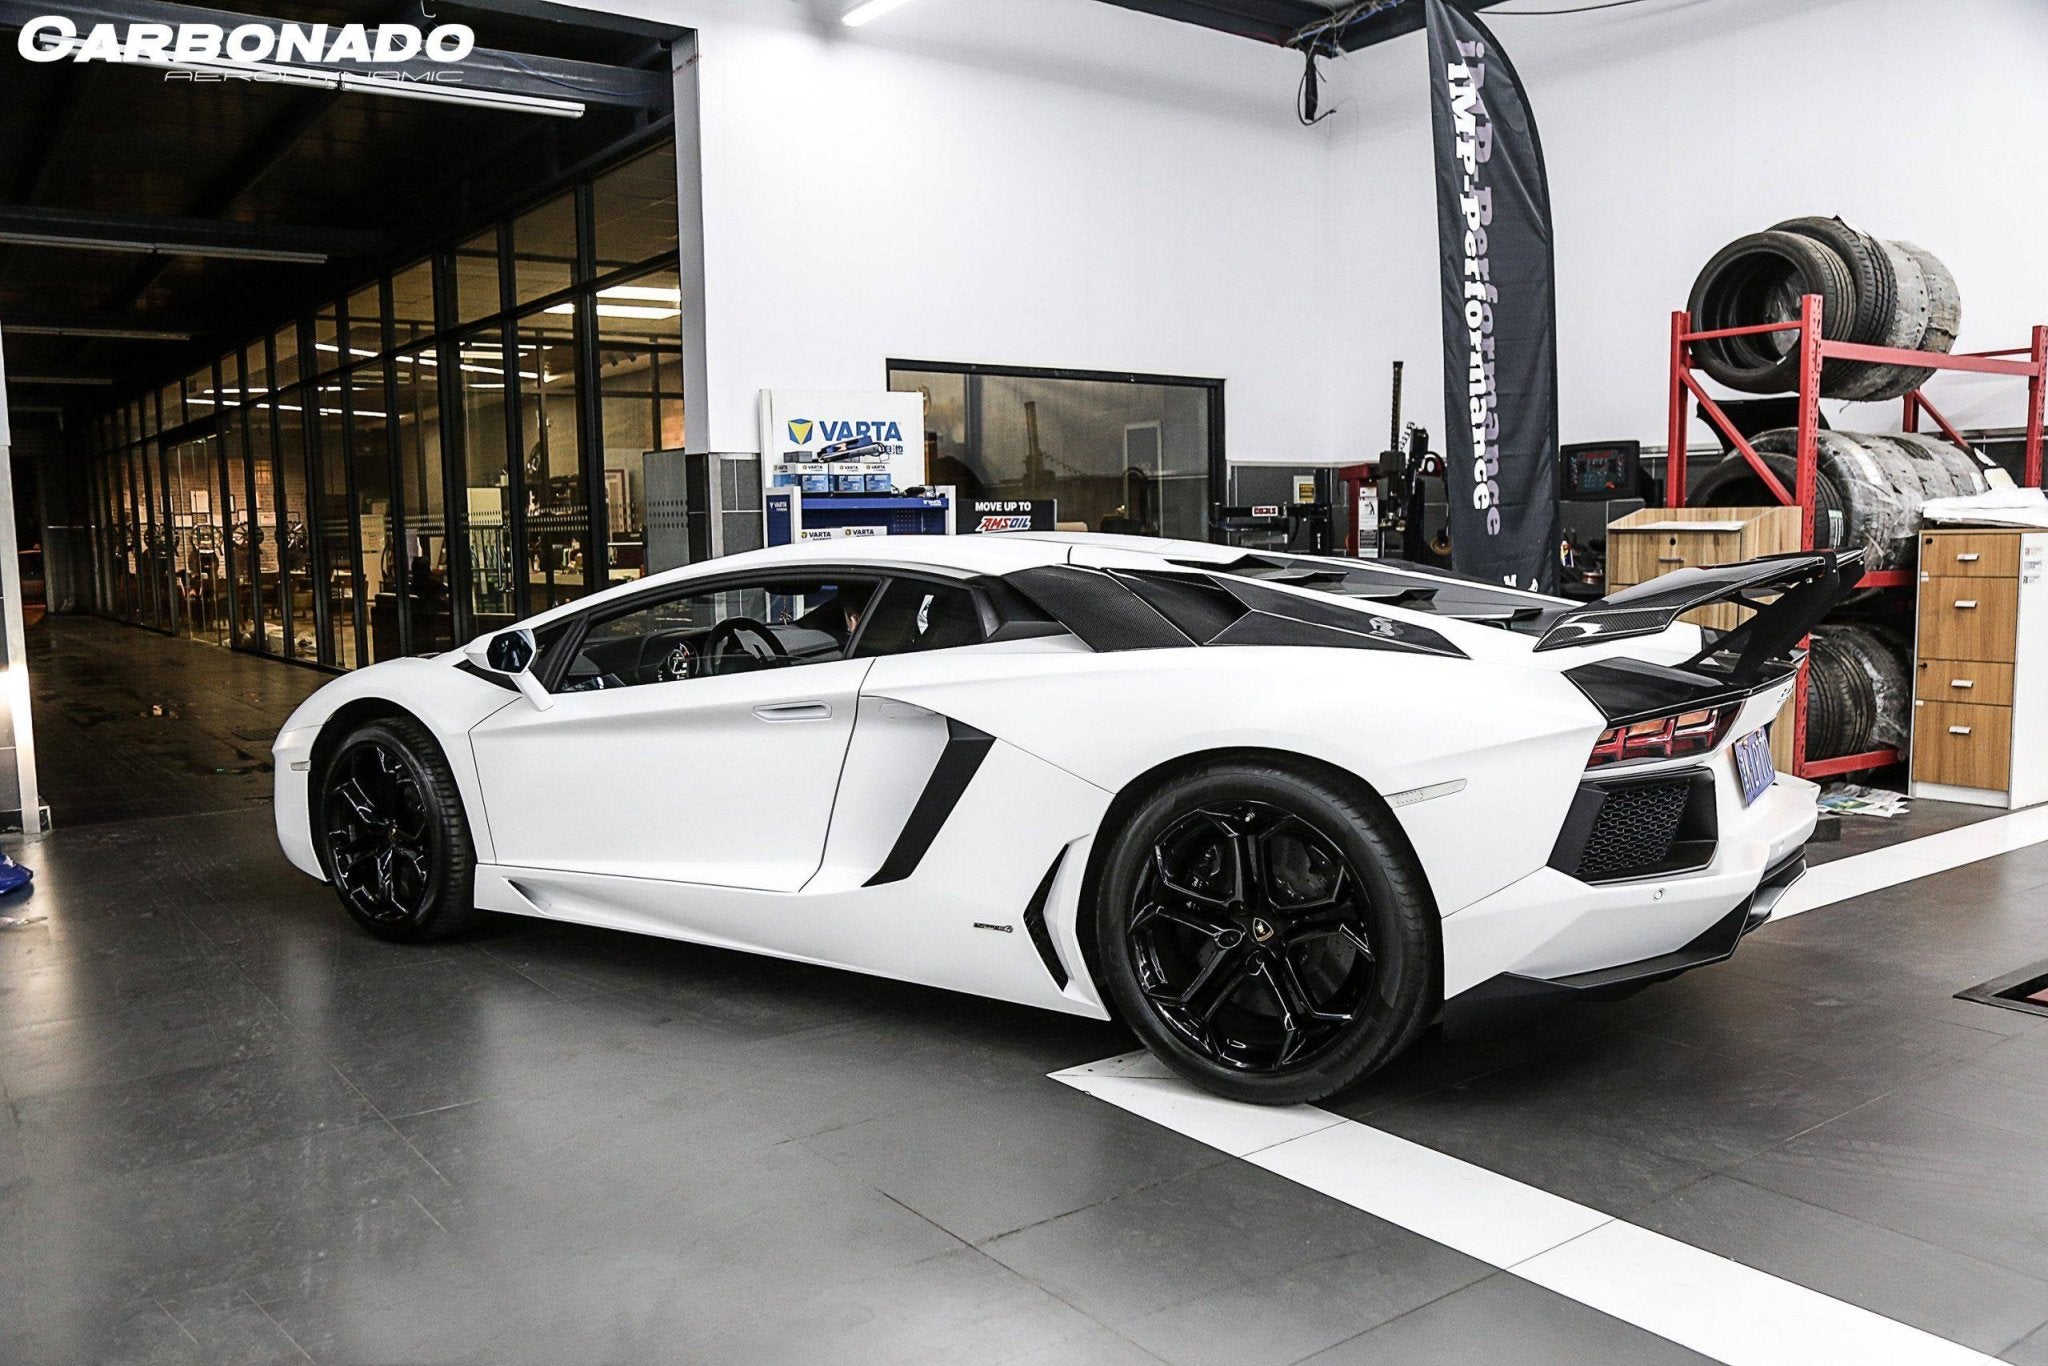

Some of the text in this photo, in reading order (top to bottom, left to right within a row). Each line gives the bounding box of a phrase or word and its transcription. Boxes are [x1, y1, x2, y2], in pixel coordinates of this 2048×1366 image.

[819, 421, 902, 442] VARTA
[975, 502, 1031, 511] MOVE UP TO
[980, 517, 1030, 532] AMSOIL
